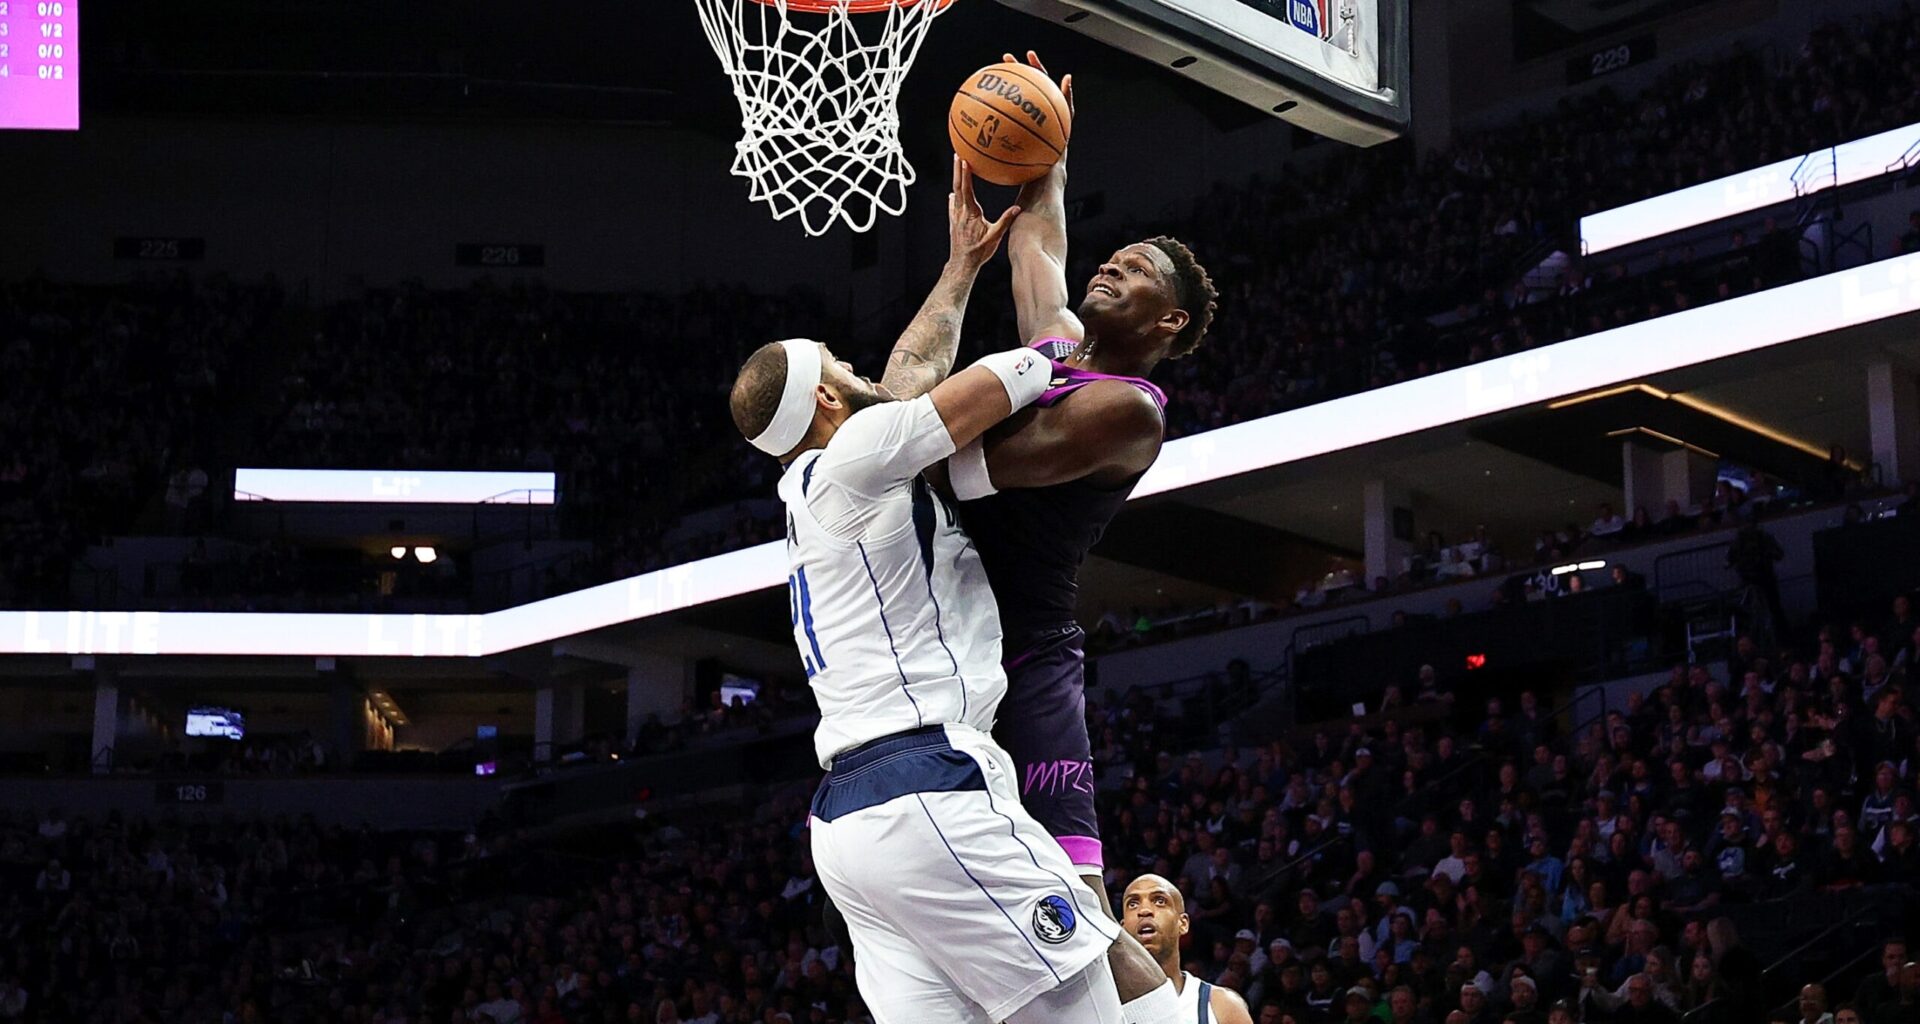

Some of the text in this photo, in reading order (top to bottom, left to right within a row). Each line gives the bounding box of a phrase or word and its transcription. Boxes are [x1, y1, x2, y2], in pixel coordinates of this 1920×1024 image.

[37, 2, 63, 16] 0/0
[1293, 0, 1314, 28] NBA
[40, 23, 63, 37] 1/2
[38, 44, 63, 58] 0/0
[1591, 44, 1631, 75] 229
[38, 64, 63, 79] 0/2
[976, 73, 1047, 127] Wilson
[481, 246, 519, 264] 226
[176, 784, 208, 801] 126
